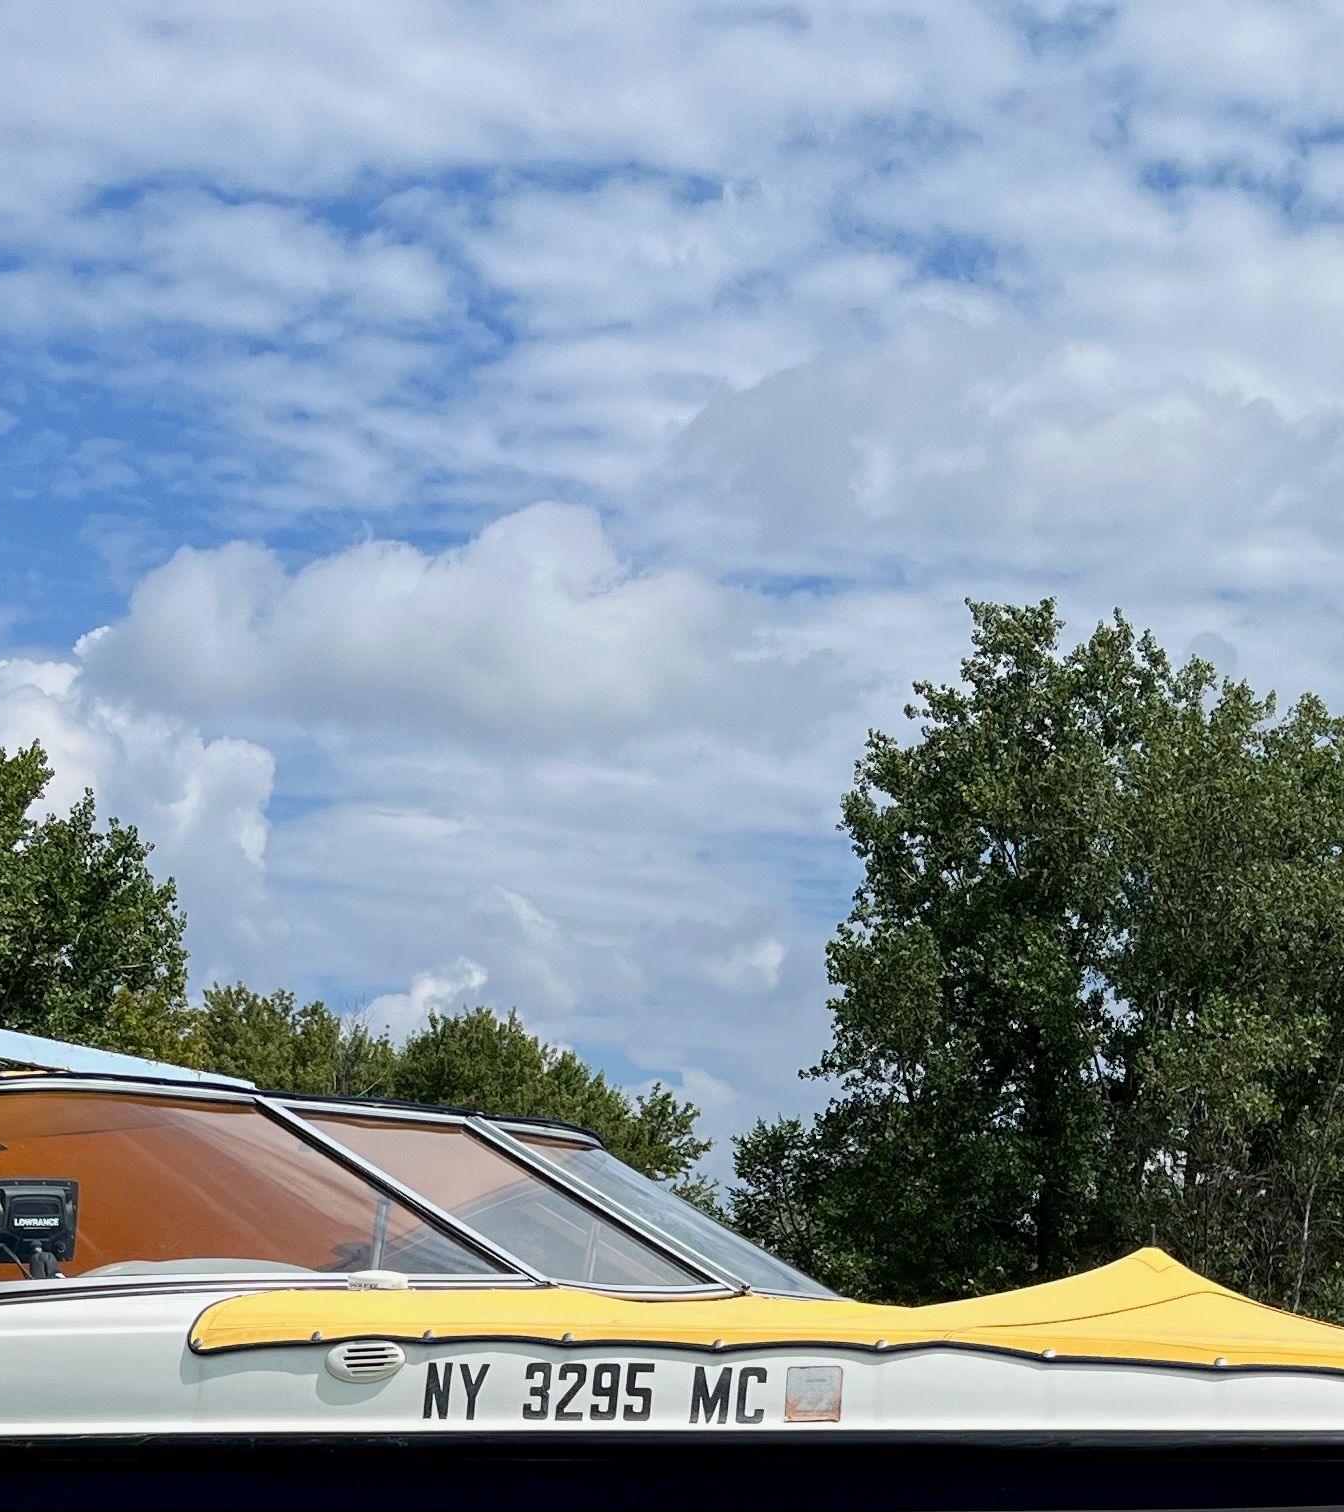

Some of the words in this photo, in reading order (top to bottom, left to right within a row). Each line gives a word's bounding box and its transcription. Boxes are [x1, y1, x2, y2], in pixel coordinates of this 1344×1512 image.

[14, 1218, 60, 1227] LOWRANCE
[422, 1361, 491, 1421] NY
[522, 1362, 656, 1423] 3295
[688, 1366, 768, 1425] MC
